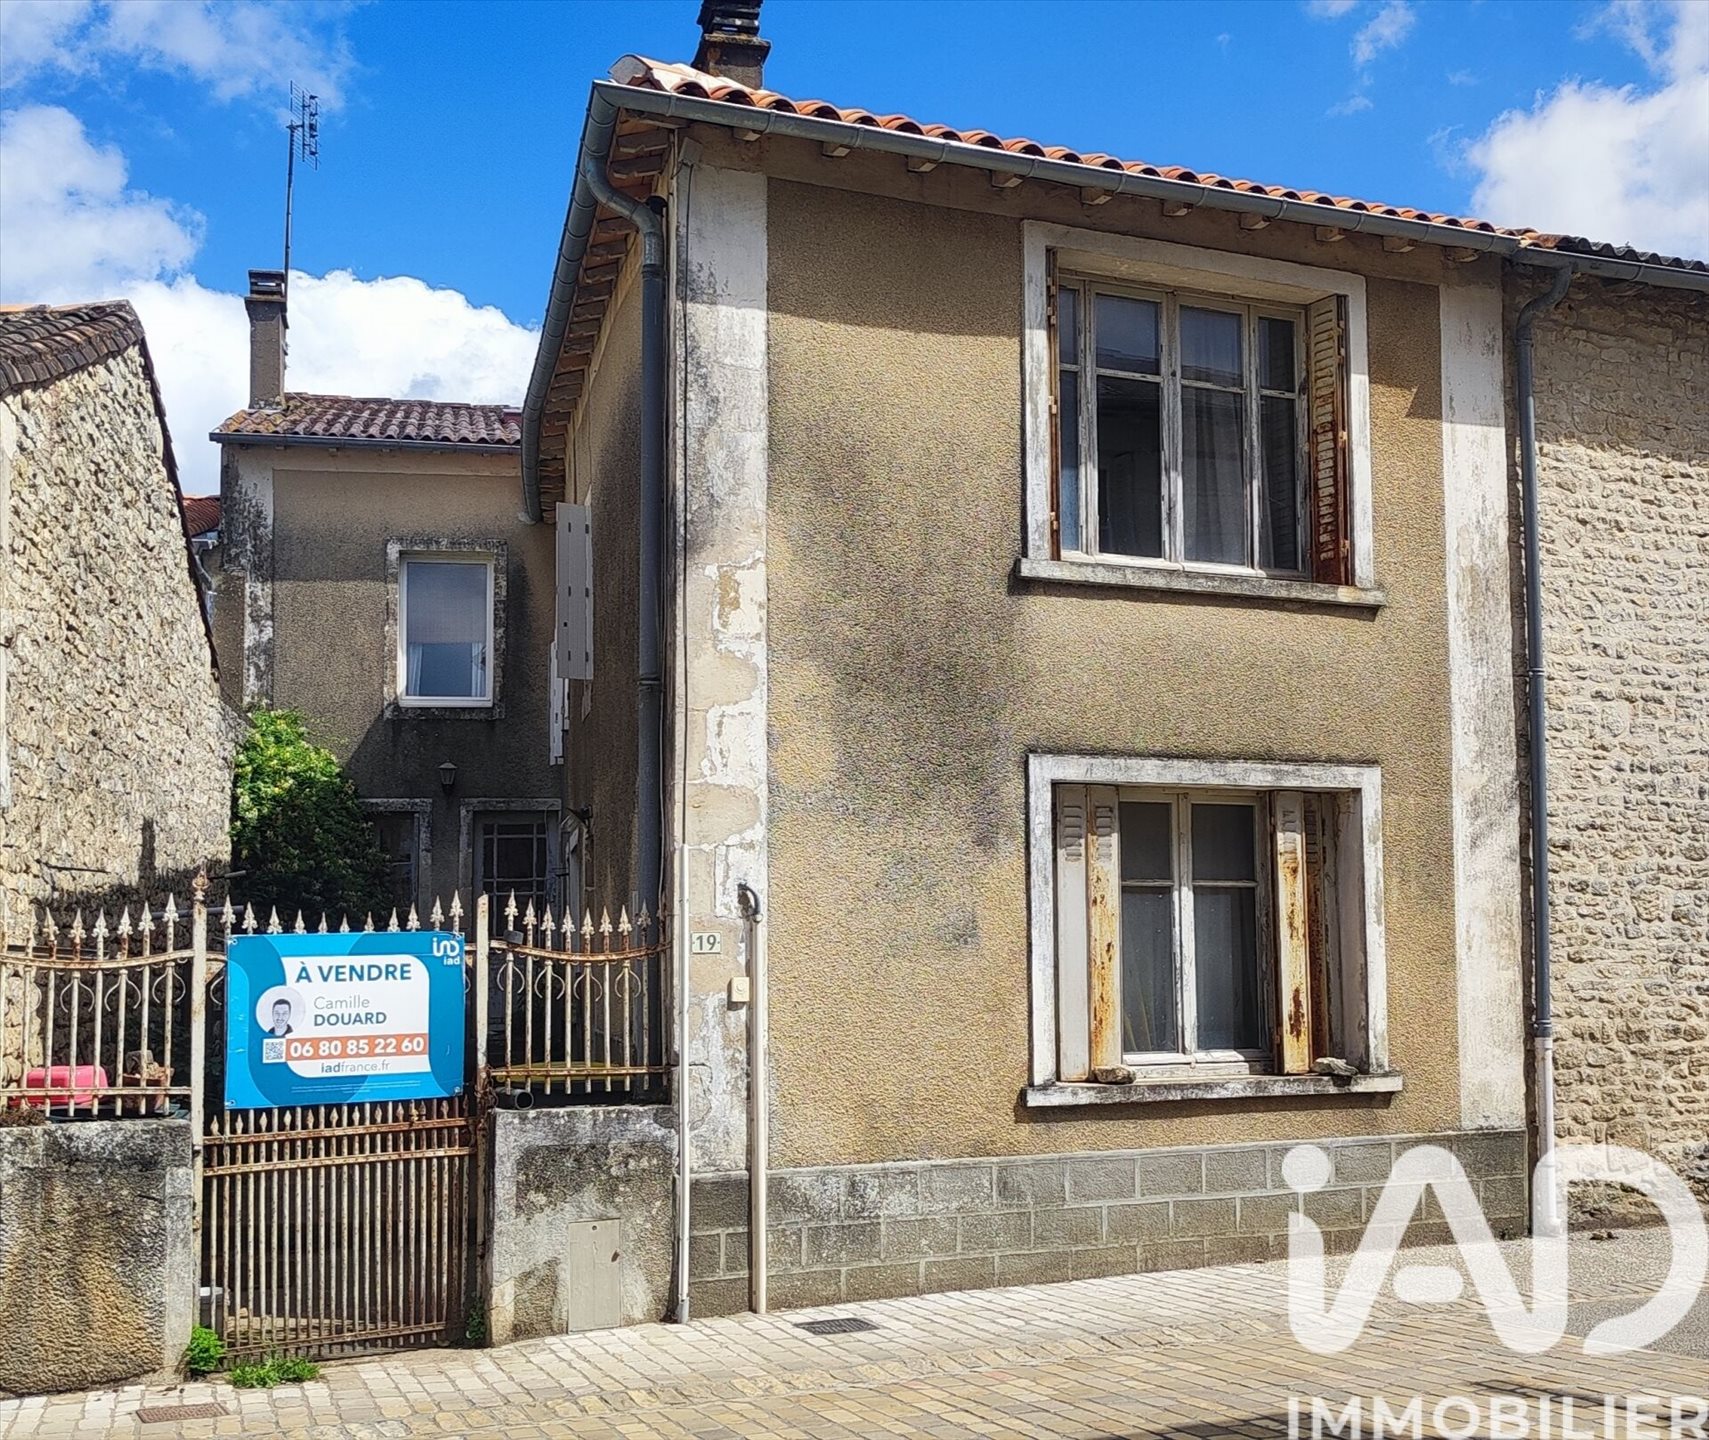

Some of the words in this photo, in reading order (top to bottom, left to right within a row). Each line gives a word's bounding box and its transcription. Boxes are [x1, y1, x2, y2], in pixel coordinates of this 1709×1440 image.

[696, 934, 717, 951] 19
[443, 956, 461, 966] iad
[295, 961, 313, 983] À
[318, 963, 412, 983] VENDRE
[314, 995, 370, 1010] Camille
[314, 1012, 387, 1027] DOUARD
[290, 1041, 314, 1058] 06
[318, 1040, 342, 1056] 80
[346, 1039, 369, 1055] 85
[374, 1038, 397, 1054] 22
[401, 1037, 424, 1052] 60
[321, 1060, 391, 1074] iadfrance.fr
